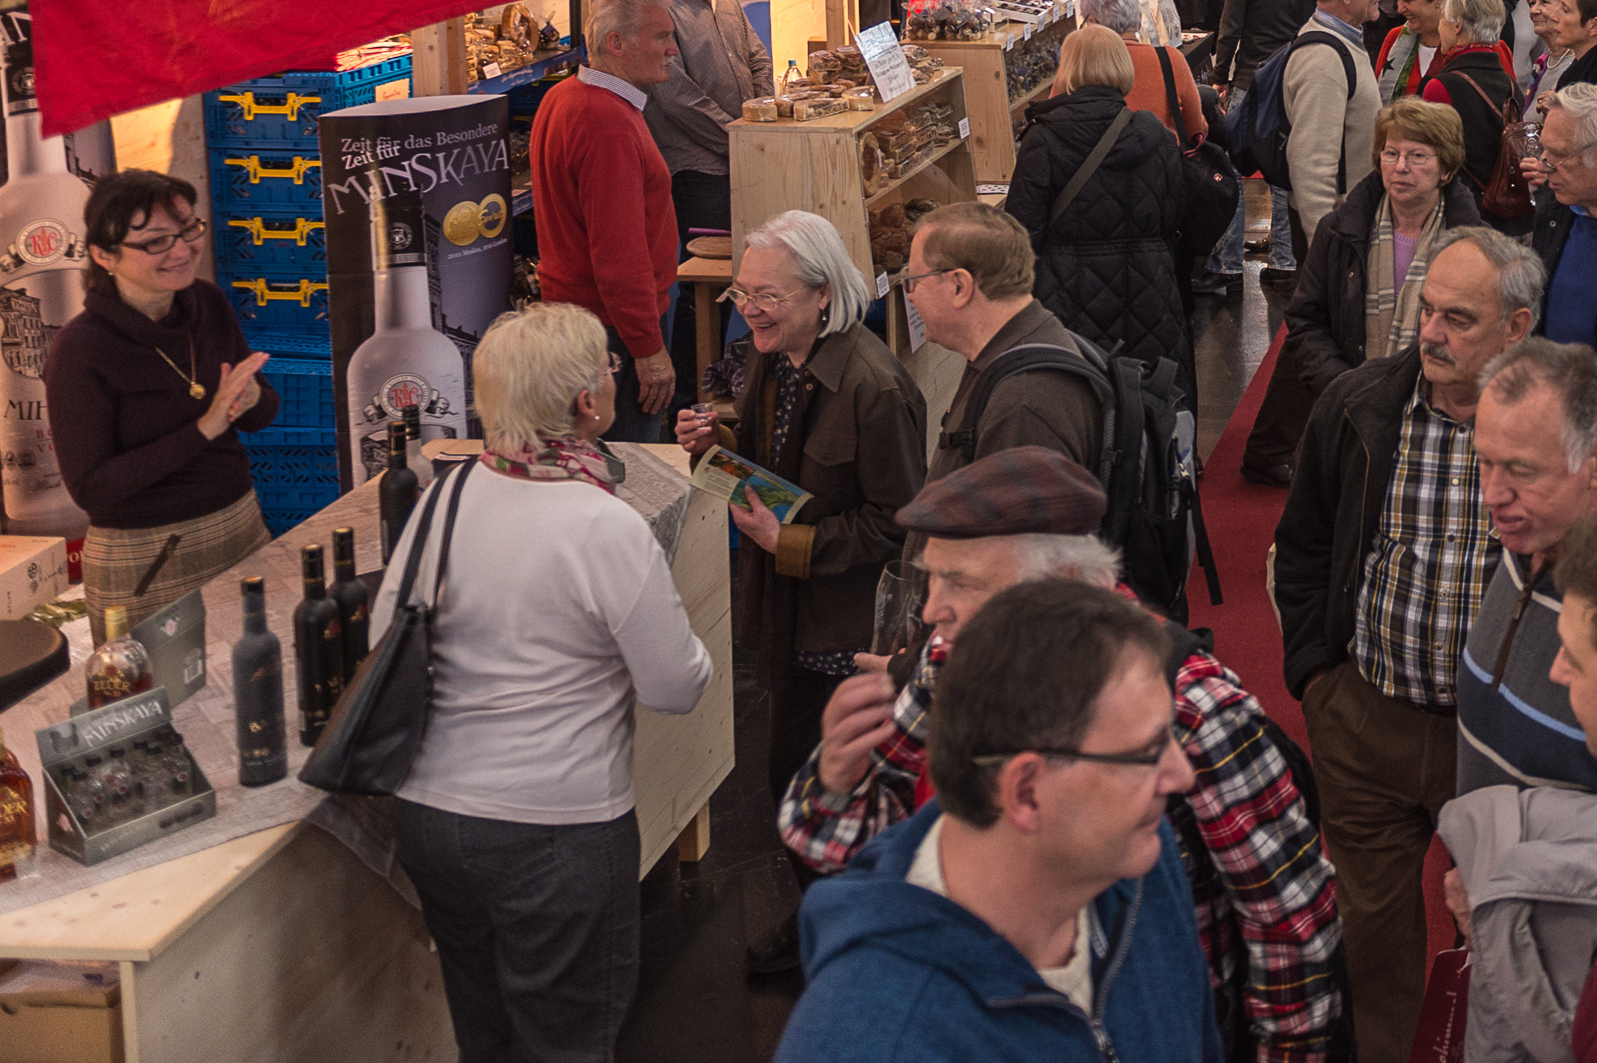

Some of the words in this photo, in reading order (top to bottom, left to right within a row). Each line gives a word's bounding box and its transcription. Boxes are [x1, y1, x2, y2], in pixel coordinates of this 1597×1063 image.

[341, 137, 372, 153] Zeit
[404, 134, 432, 150] das
[436, 123, 498, 146] Besondere
[327, 138, 510, 216] MINSKAYA
